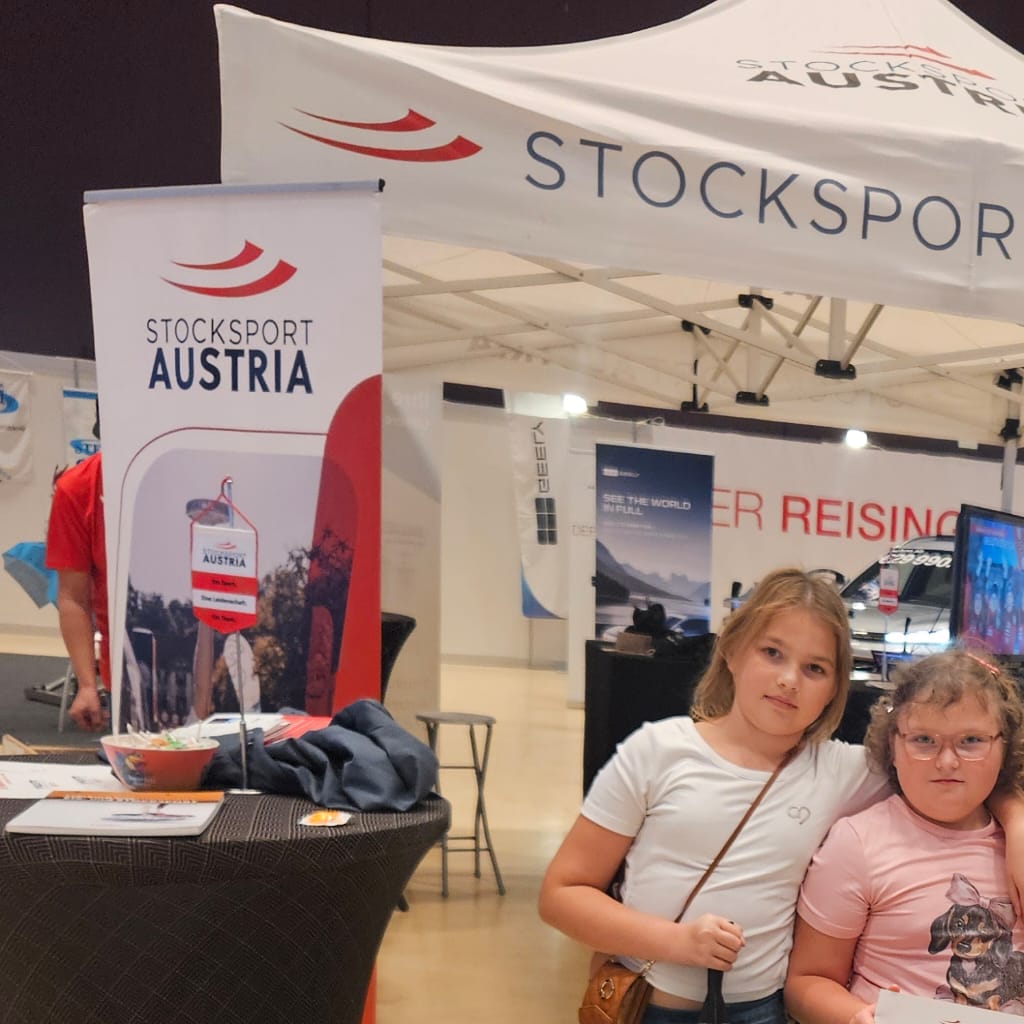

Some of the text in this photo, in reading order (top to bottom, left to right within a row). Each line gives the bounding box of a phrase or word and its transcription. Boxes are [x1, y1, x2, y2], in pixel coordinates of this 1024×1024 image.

[147, 318, 313, 345] STOCKSPORT
[149, 347, 313, 394] AUSTRIA
[532, 422, 550, 493] GEELY
[603, 494, 691, 510] SEE THE WORLD
[603, 504, 643, 515] IN FULL
[203, 555, 246, 568] AUSTRIA
